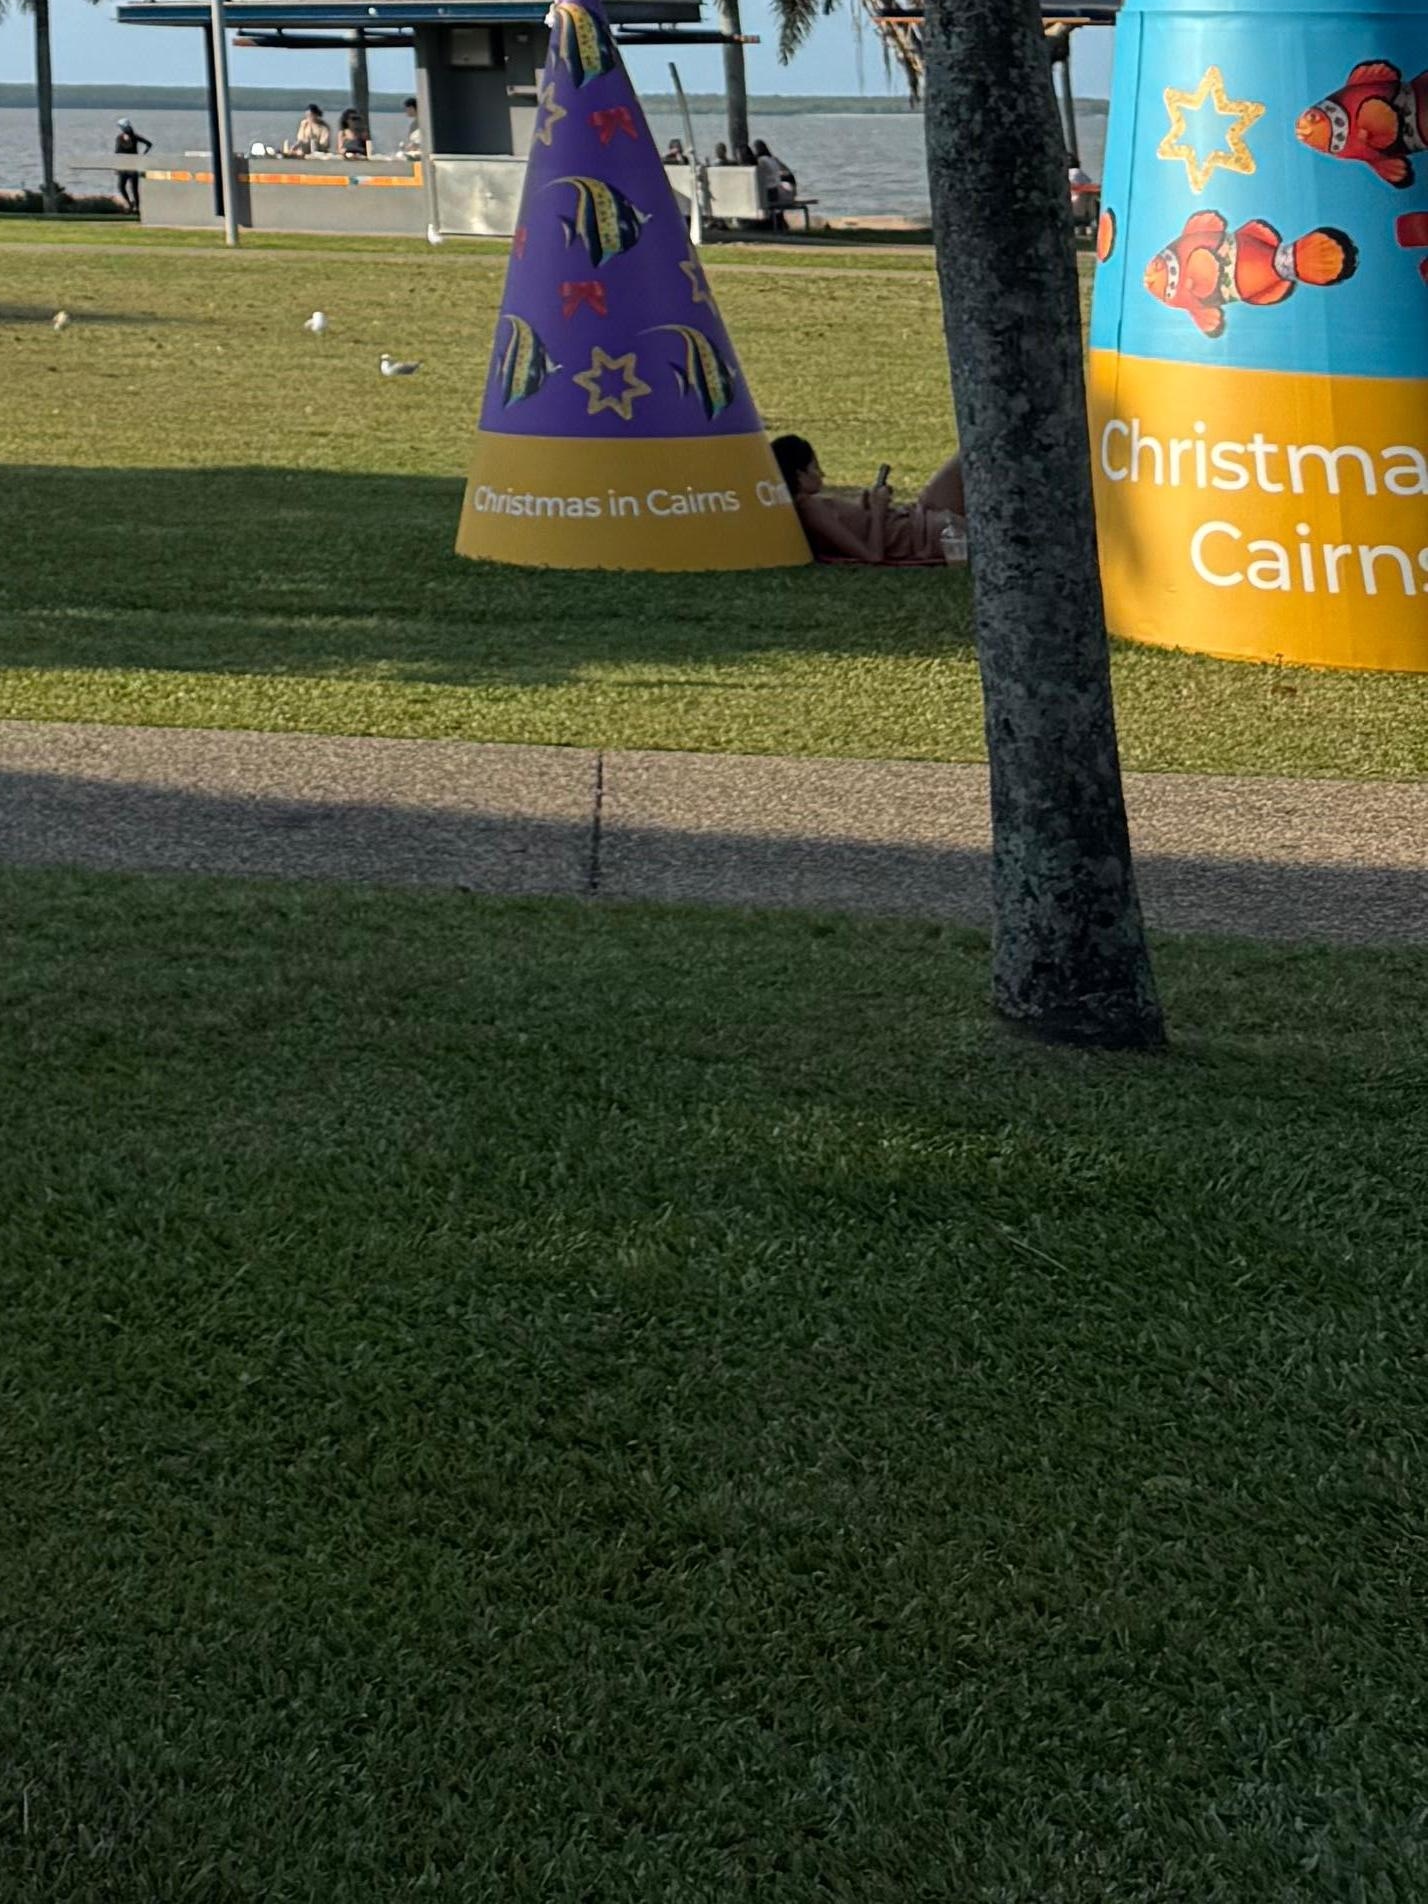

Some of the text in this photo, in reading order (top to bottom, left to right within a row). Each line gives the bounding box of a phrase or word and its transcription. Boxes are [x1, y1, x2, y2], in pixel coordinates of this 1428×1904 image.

[474, 485, 602, 518] Christmas
[607, 489, 640, 517] in
[646, 486, 741, 516] Cairns
